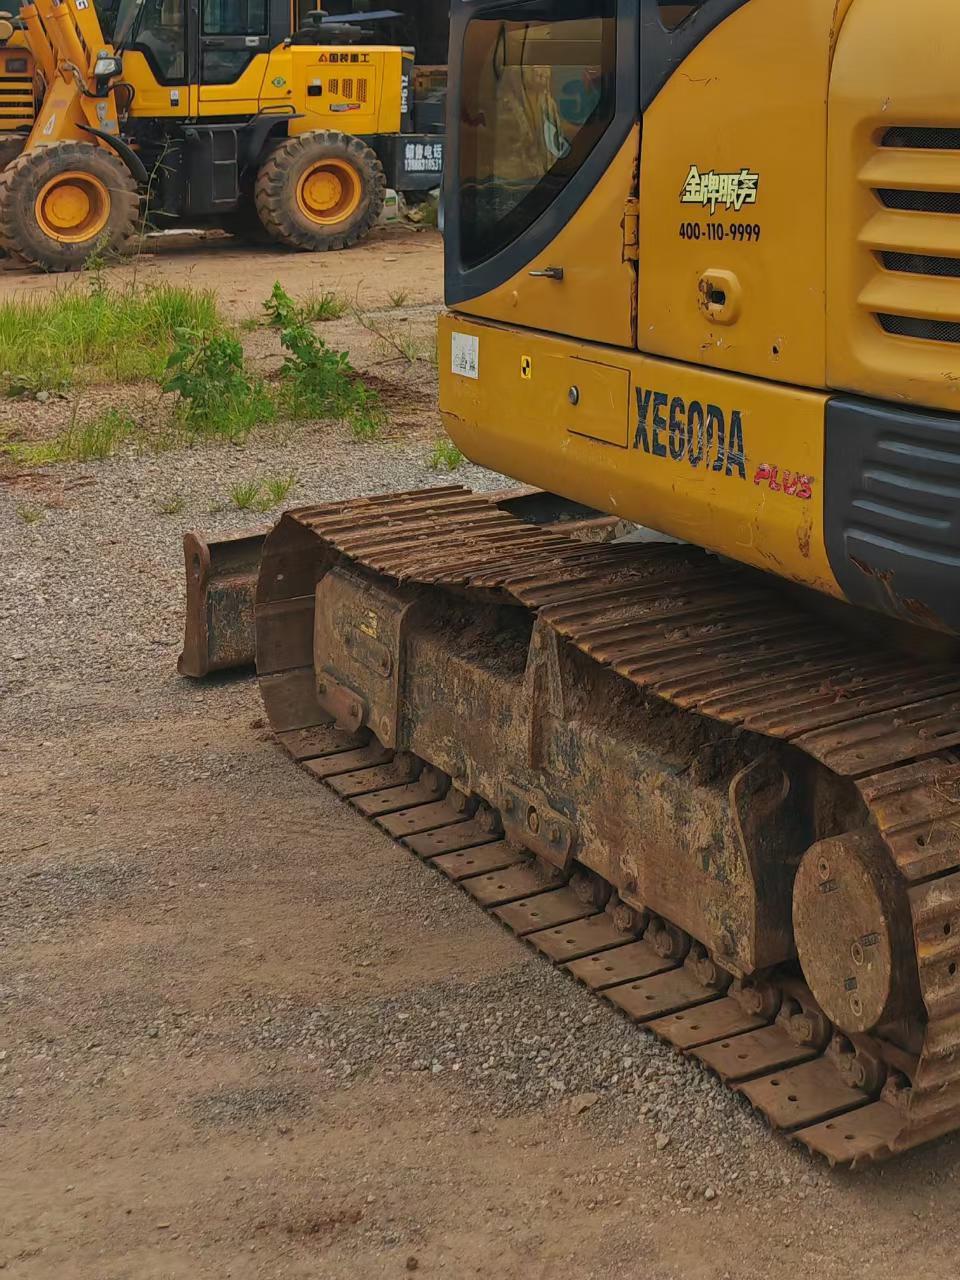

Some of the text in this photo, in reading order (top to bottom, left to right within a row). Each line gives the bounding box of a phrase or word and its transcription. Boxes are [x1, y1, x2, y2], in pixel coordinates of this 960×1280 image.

[679, 164, 760, 216] 金牌服务
[679, 222, 761, 242] 400-110-9999
[633, 386, 815, 500] XE60DA PLUS
